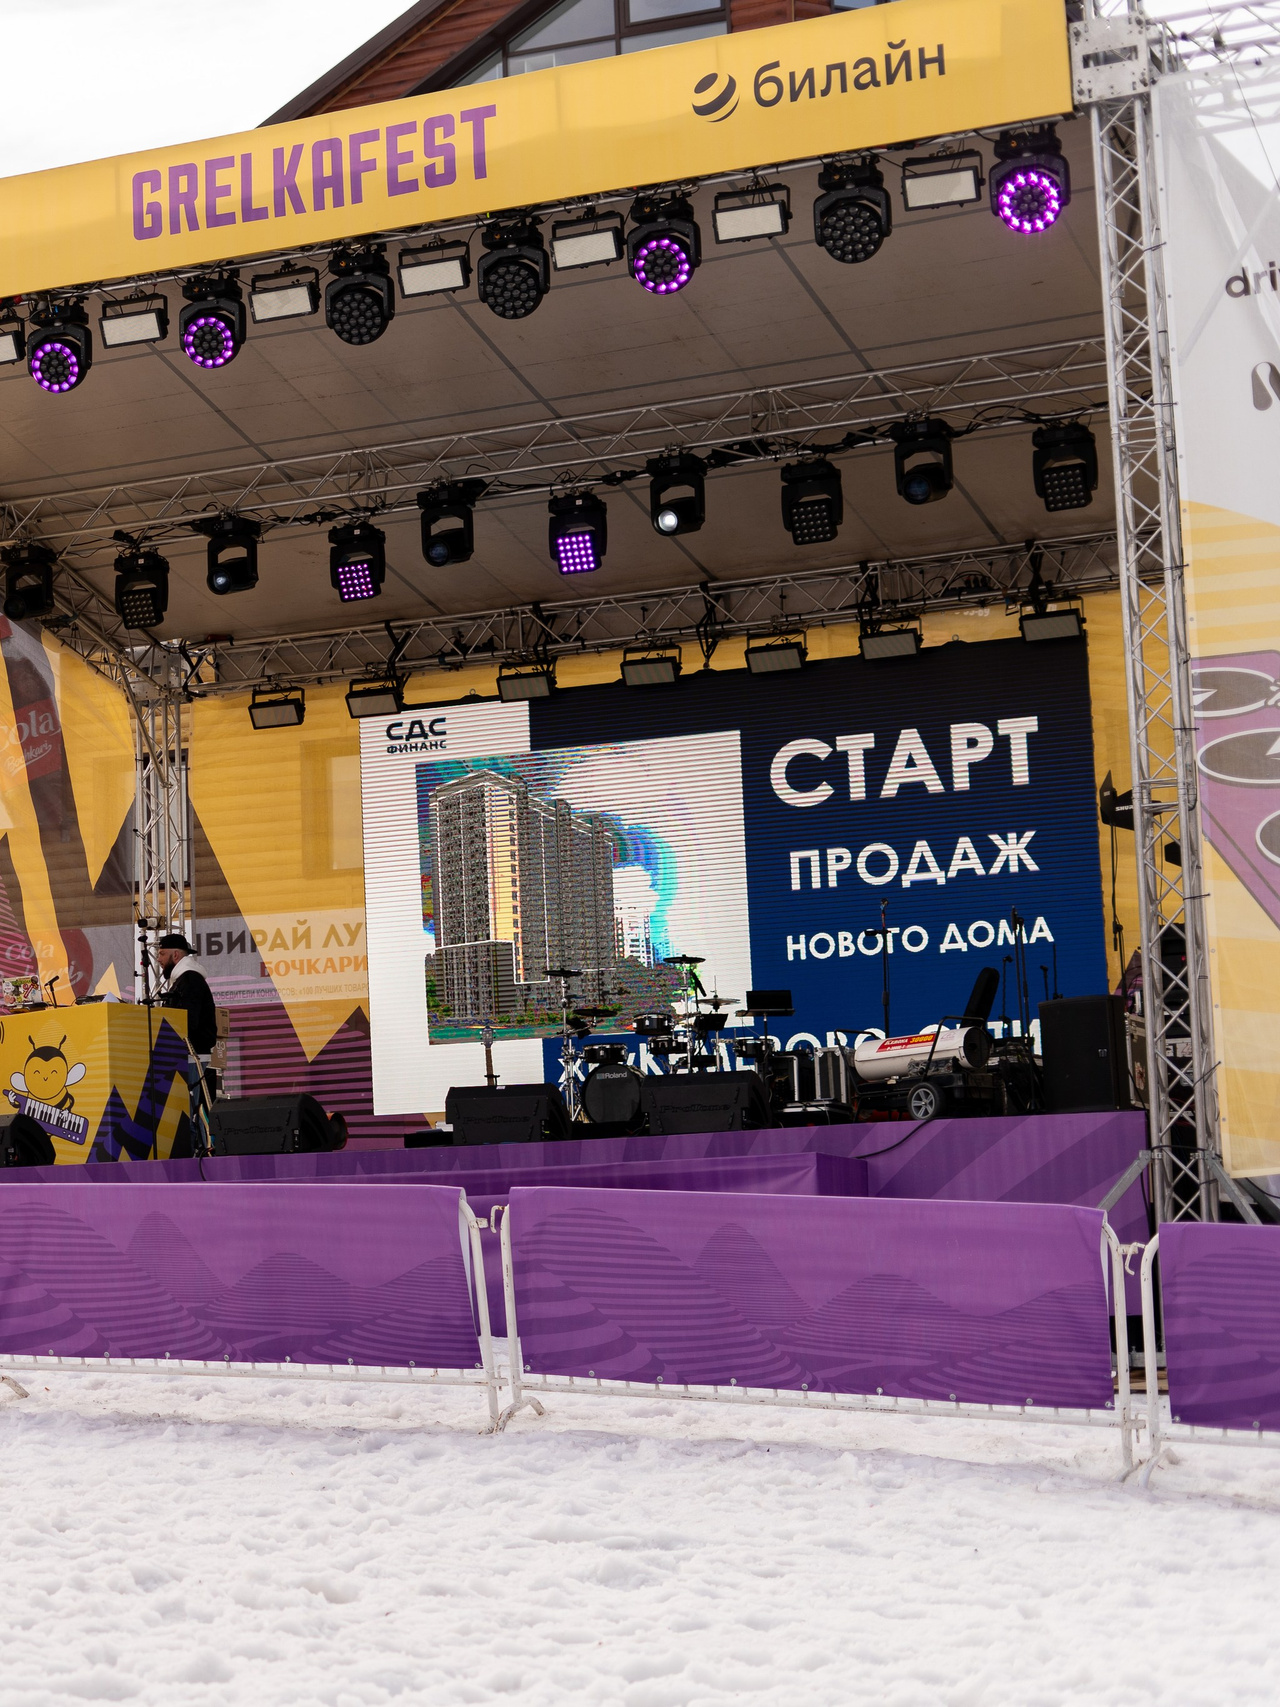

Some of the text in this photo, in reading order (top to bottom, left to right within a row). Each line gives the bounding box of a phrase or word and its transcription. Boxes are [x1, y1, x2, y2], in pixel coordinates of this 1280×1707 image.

[753, 38, 946, 108] билайн
[132, 103, 497, 241] GRELKAFEST
[1225, 260, 1280, 298] dri
[386, 717, 447, 741] СДС
[387, 740, 447, 754] ФИНАНС
[770, 715, 1039, 807] СТАРТ
[789, 830, 1040, 891] ПРОДАЖ
[4, 940, 55, 961] Cola
[322, 921, 364, 949] ЛУ
[786, 916, 1055, 961] НОВОГО ДОМА
[315, 985, 343, 994] ЛУЧШИХ
[604, 1071, 628, 1080] Roland
